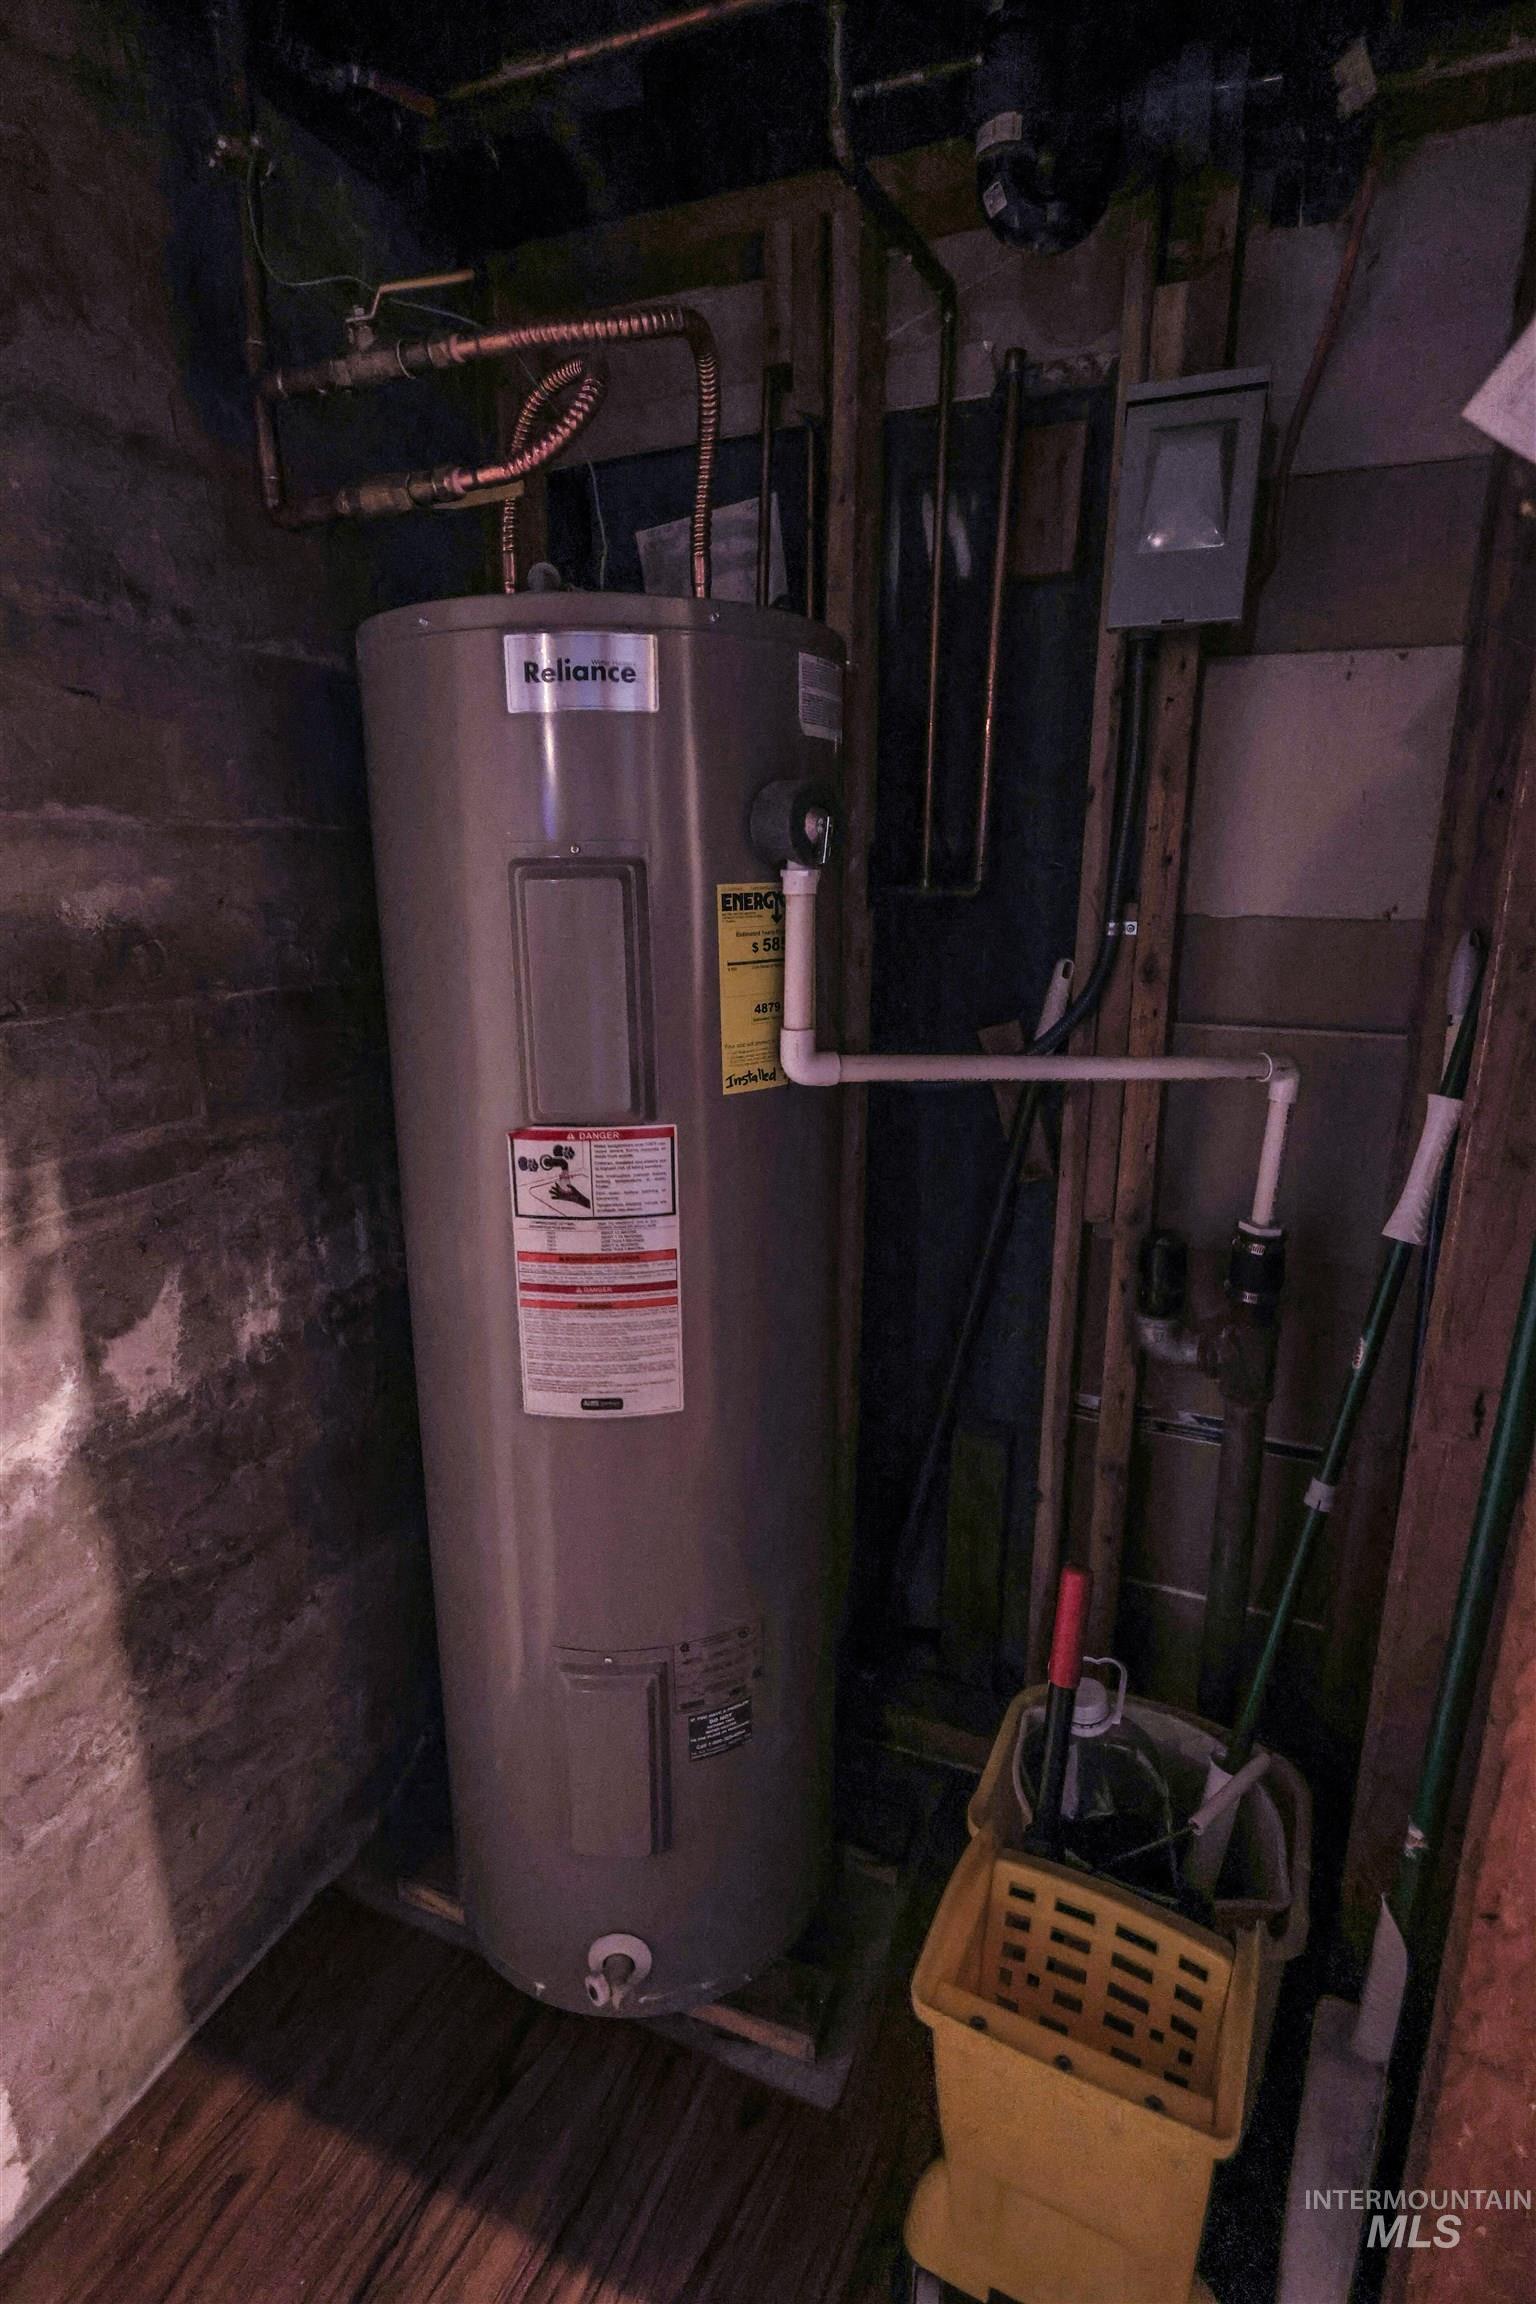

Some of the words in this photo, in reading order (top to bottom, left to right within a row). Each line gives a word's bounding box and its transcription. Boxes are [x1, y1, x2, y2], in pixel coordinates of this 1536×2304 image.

[524, 658, 636, 683] Reliance
[752, 942, 759, 953] $
[754, 1001, 781, 1014] 4879
[726, 1067, 776, 1088] Installed
[578, 1131, 621, 1140] DANGER
